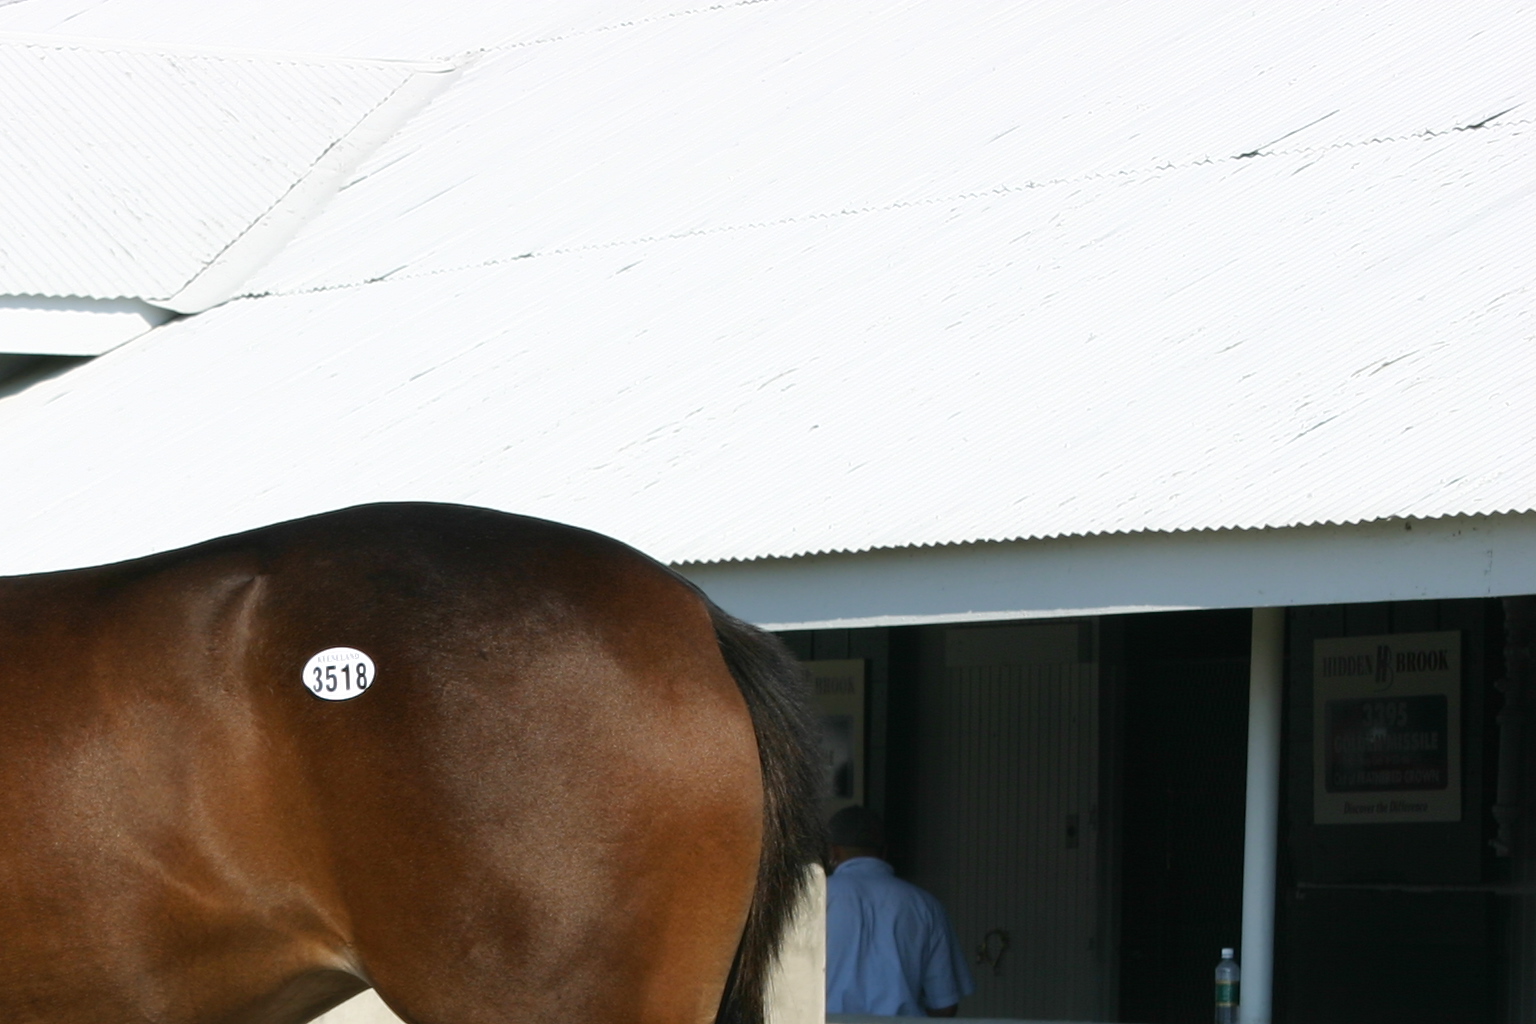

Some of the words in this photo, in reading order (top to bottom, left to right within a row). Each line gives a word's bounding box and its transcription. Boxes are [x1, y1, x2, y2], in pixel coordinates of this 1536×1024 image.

[313, 662, 368, 693] 3518
[1322, 654, 1373, 678] HIDDEN
[1396, 649, 1449, 673] BROOK
